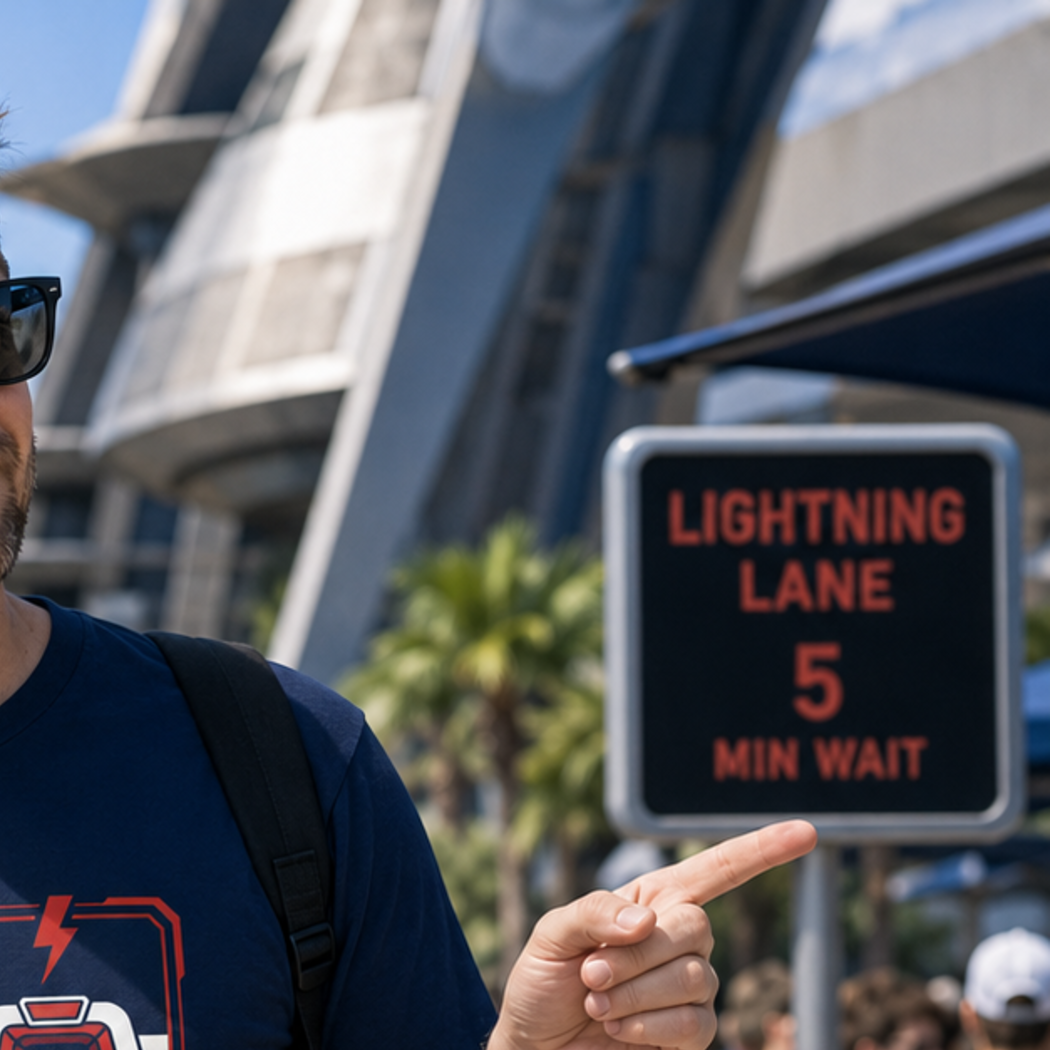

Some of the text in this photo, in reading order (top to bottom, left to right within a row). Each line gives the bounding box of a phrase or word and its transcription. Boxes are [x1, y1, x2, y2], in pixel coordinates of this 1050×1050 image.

[669, 488, 964, 545] LIGHTNING
[741, 560, 893, 611] LANE
[794, 643, 842, 721] 5
[715, 738, 926, 779] MIN WAIT
